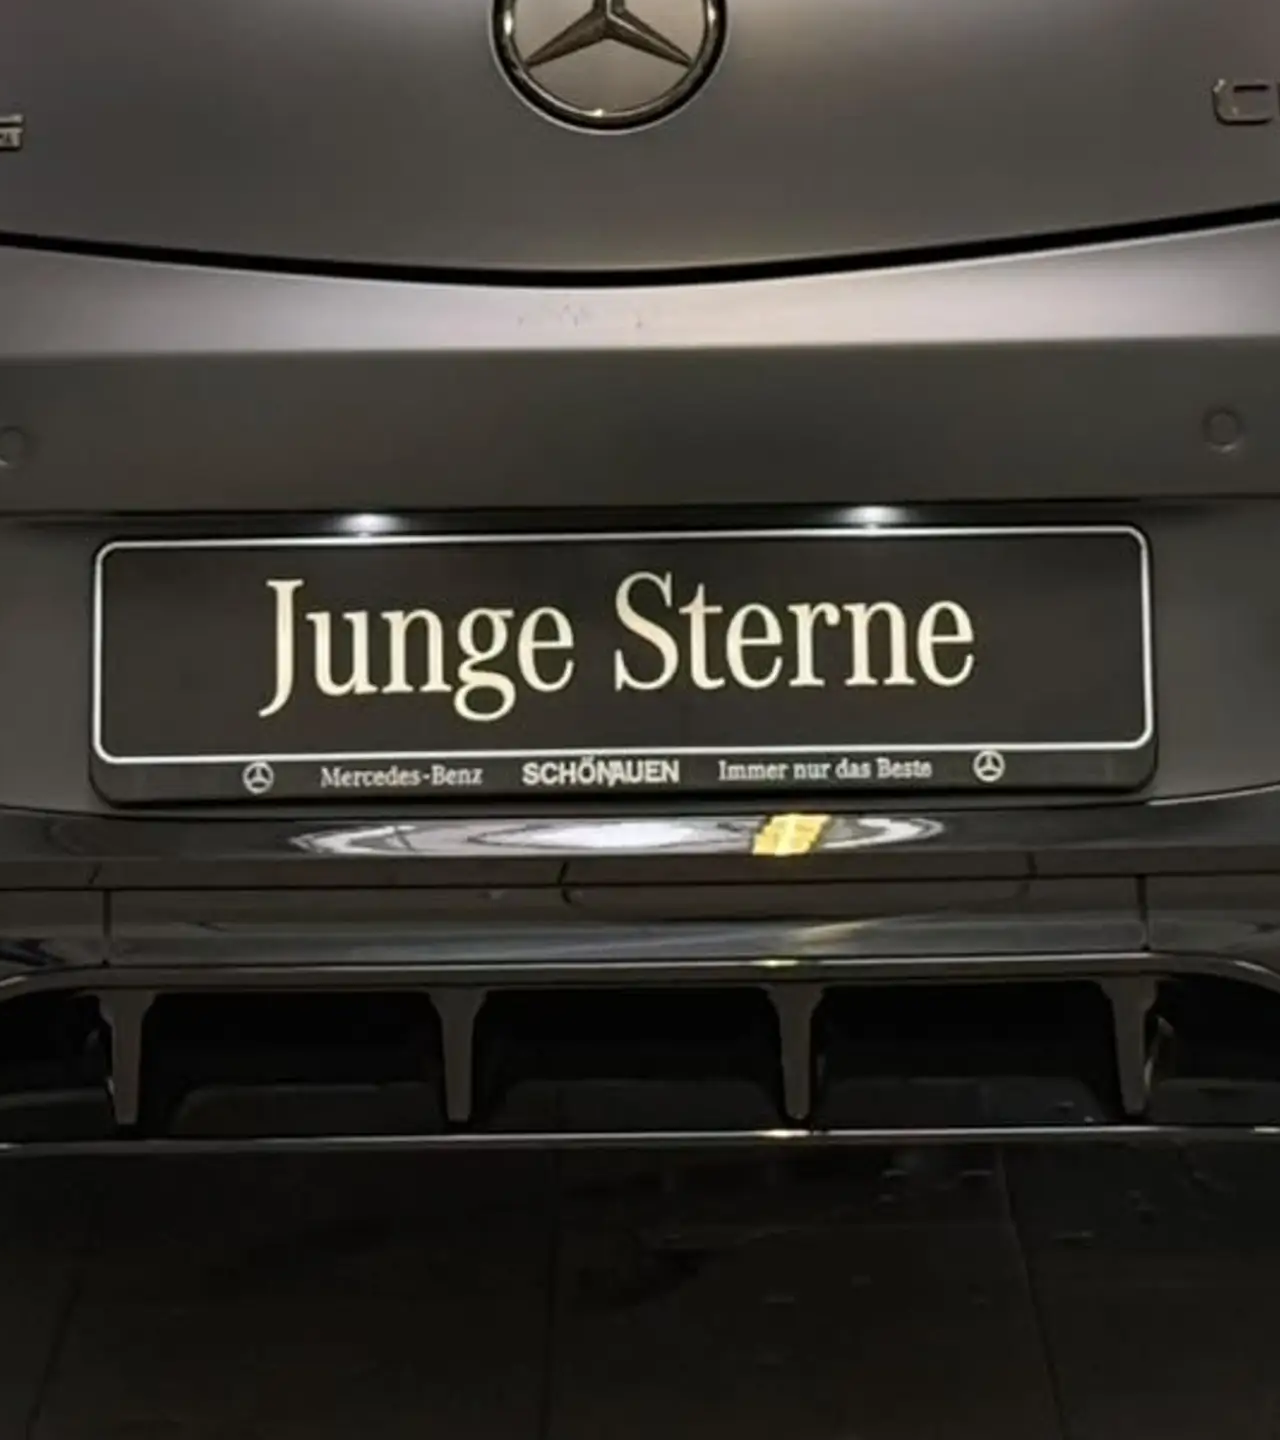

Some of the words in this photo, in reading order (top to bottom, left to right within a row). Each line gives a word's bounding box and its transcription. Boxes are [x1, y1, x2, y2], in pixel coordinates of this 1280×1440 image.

[259, 579, 574, 722] Junge
[615, 572, 974, 692] Sterne
[320, 765, 484, 788] Mercedes-Benz
[522, 755, 680, 787] SCHÖNAUEN
[718, 760, 789, 781] Immer
[793, 761, 832, 780] nur
[835, 757, 871, 779] das
[875, 756, 933, 779] Beste
